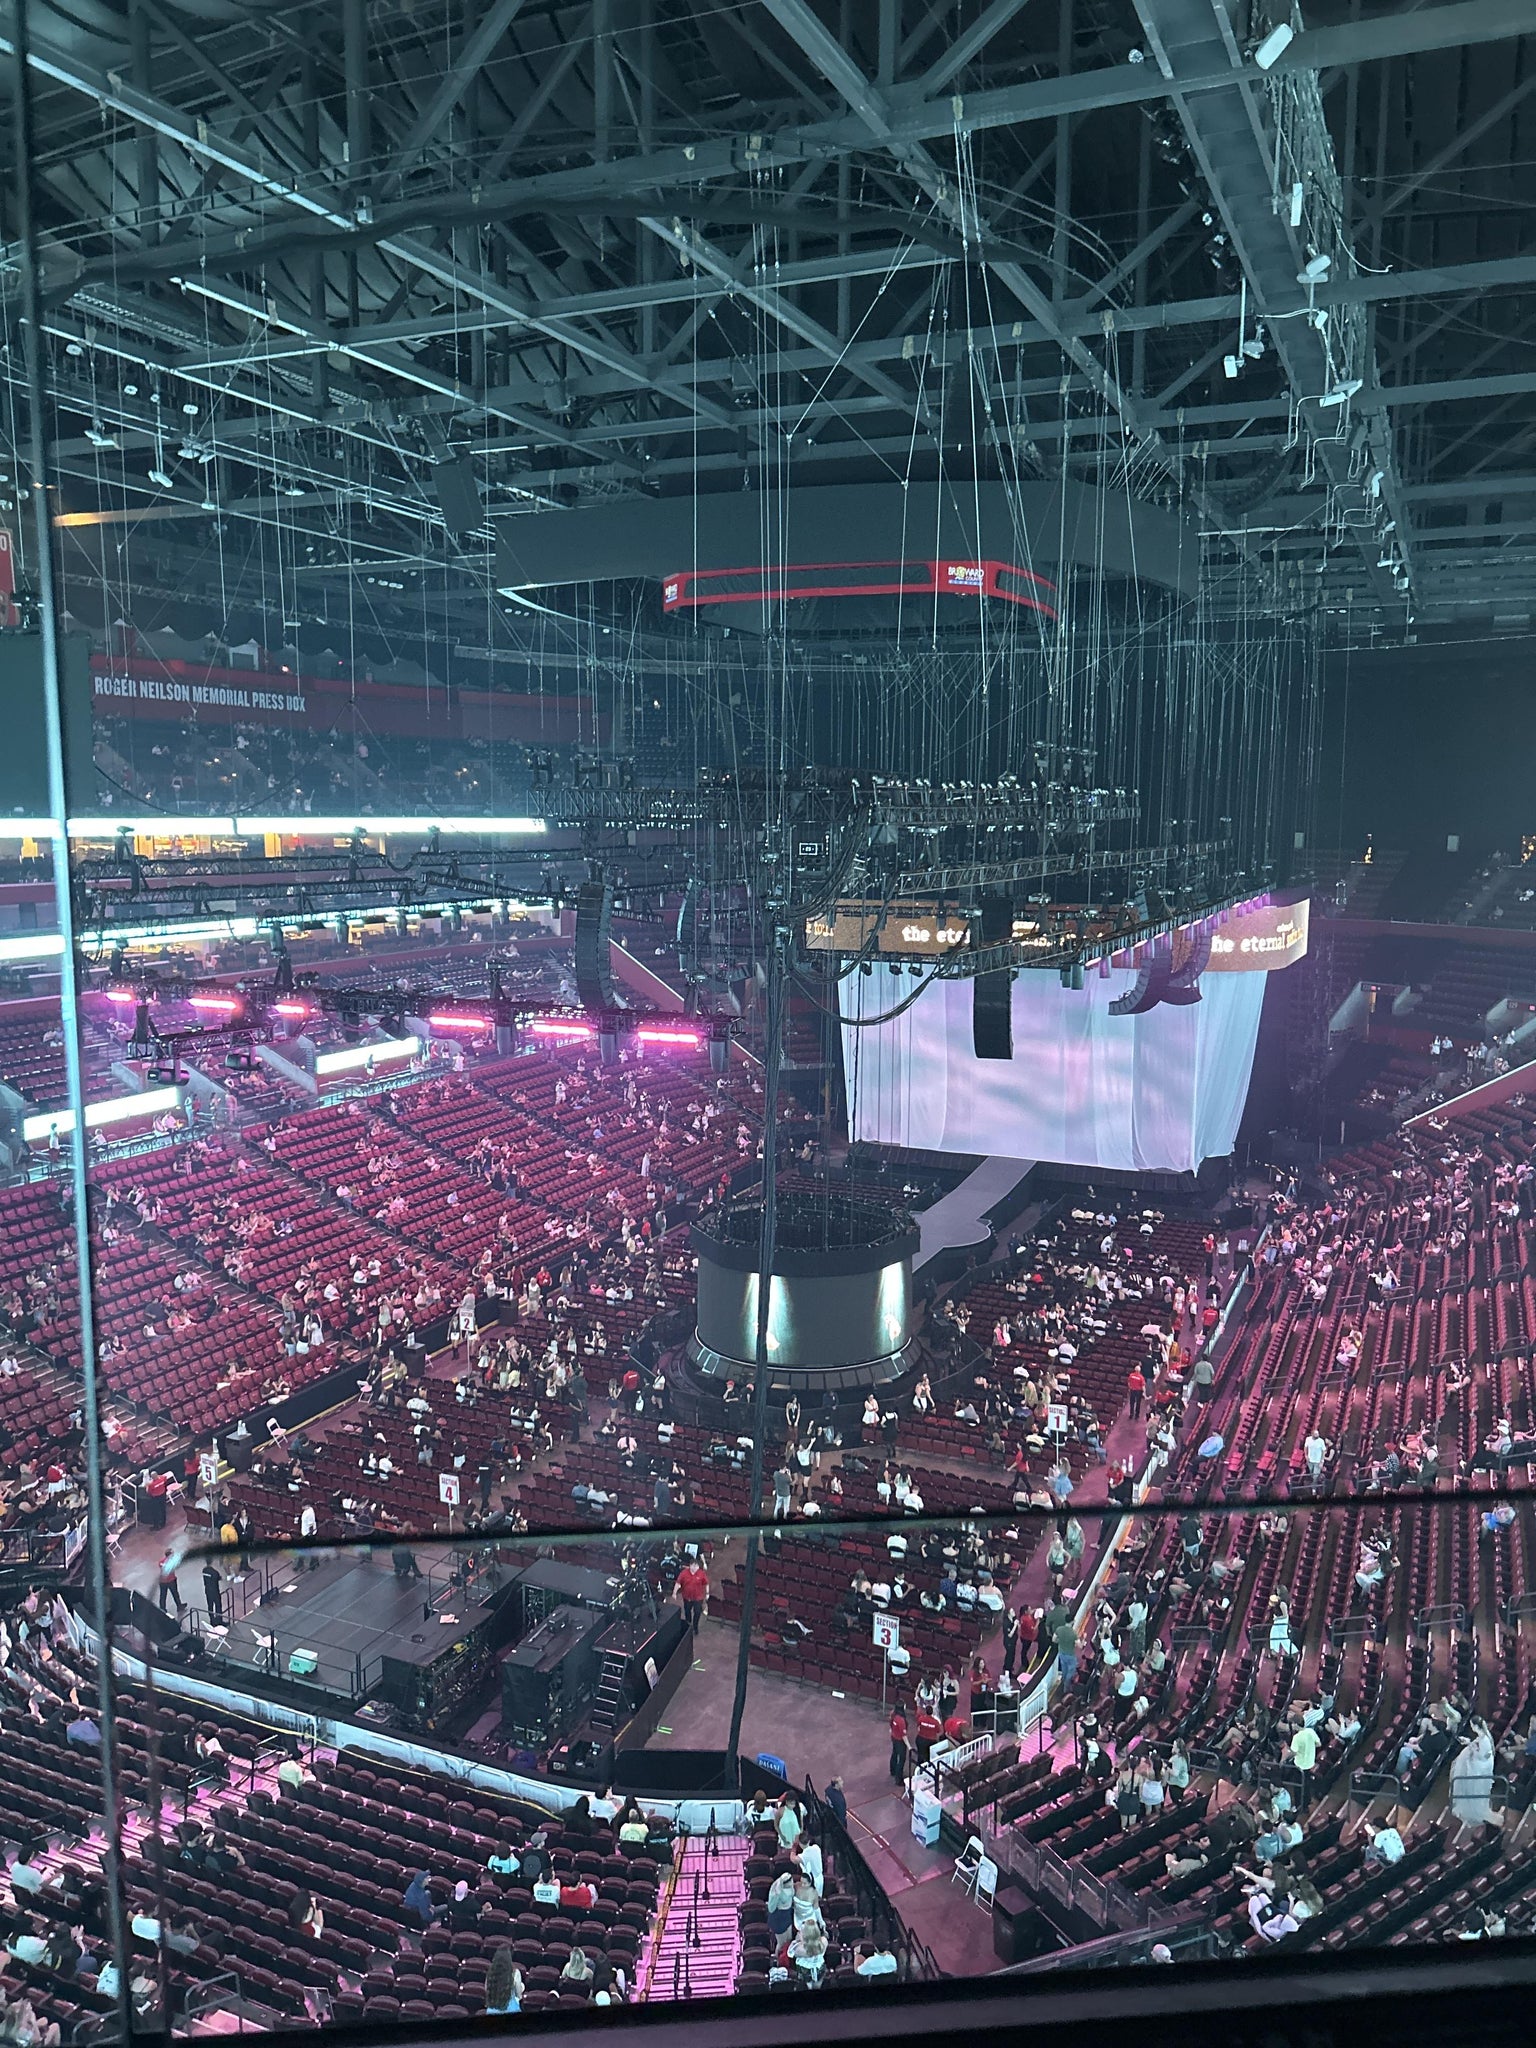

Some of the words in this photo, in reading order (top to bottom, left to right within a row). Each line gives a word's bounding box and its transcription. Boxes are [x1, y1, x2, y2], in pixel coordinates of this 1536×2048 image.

[94, 676, 137, 698] ROGER
[139, 680, 190, 702] NEILSON
[192, 685, 250, 708] MEMORIAL
[252, 691, 285, 710] PRESS
[286, 695, 306, 712] BOX
[901, 924, 930, 943] the
[1240, 932, 1285, 953] eternal
[464, 1317, 470, 1329] 2
[1054, 1415, 1060, 1429] 1
[205, 1466, 212, 1481] 5
[445, 1486, 454, 1501] 4
[876, 1617, 897, 1629] SECTION
[881, 1627, 891, 1646] 3
